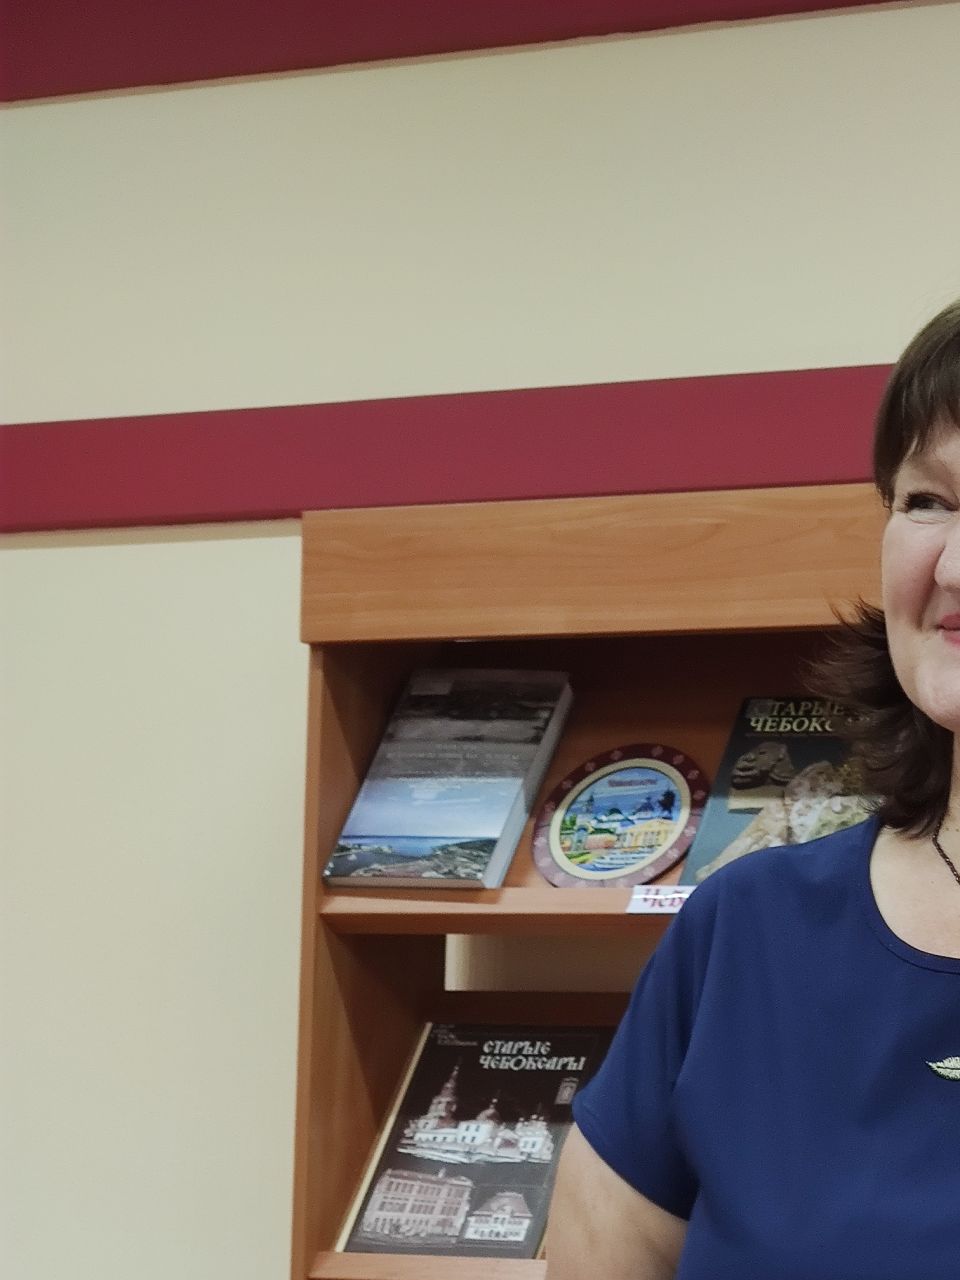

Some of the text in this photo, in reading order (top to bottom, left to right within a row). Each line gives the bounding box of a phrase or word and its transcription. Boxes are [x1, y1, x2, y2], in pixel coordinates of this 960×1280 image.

[765, 701, 844, 717] ТАРЫЕ
[482, 1040, 551, 1054] СТАРЫЕ
[479, 1055, 586, 1071] ЧЕБОКСАРЫ
